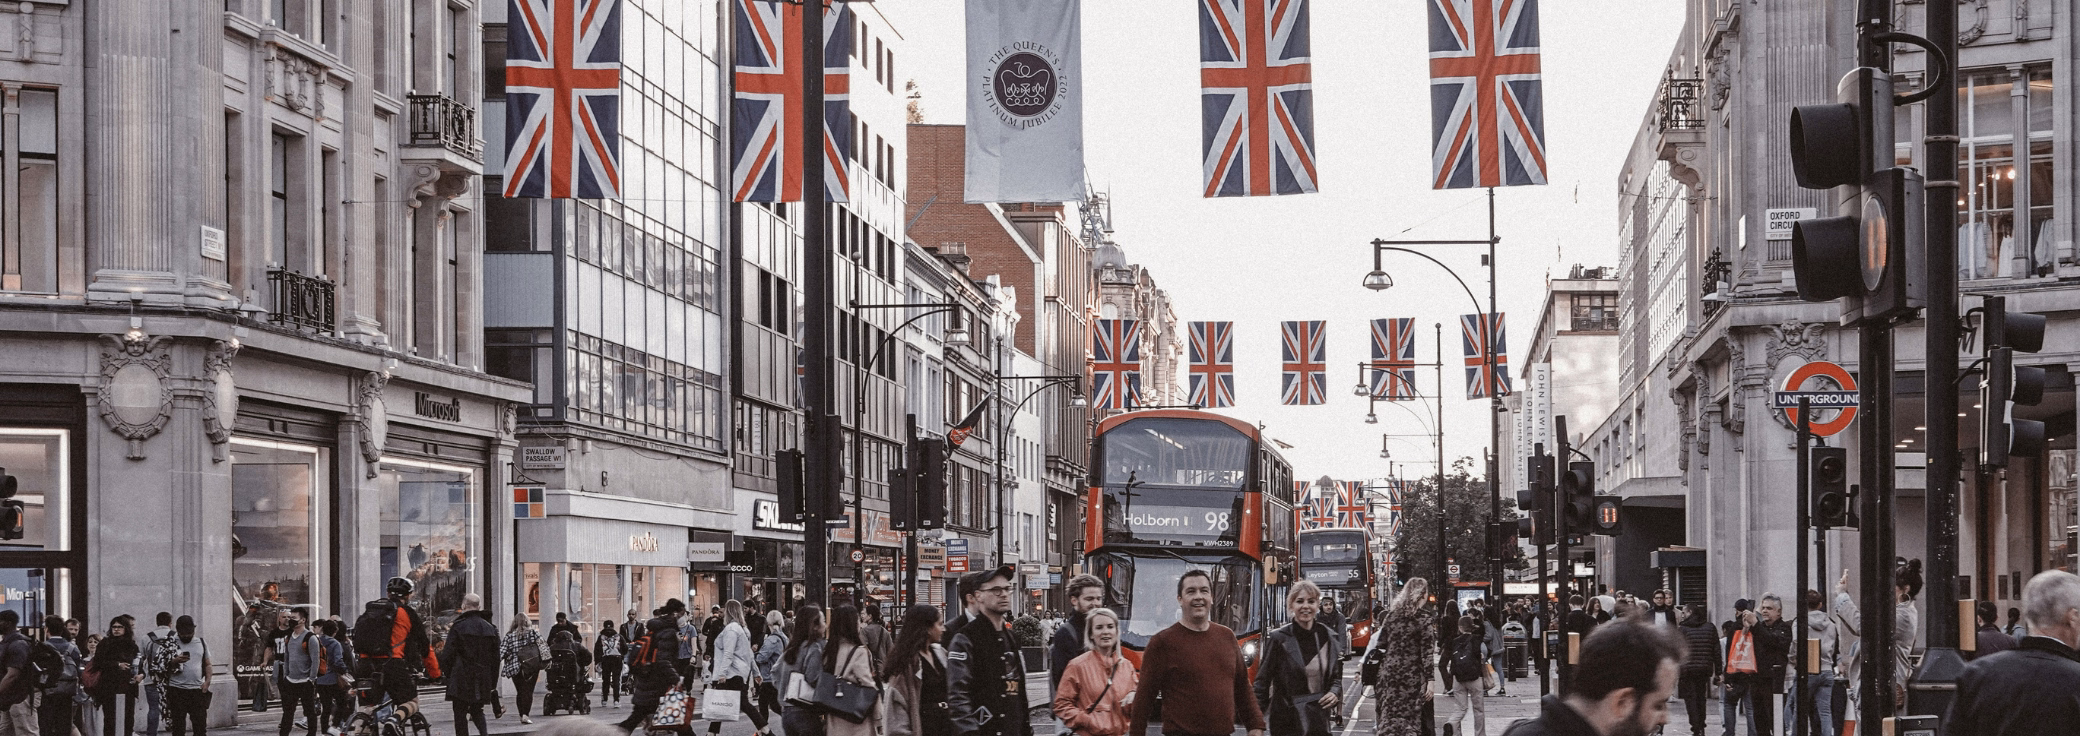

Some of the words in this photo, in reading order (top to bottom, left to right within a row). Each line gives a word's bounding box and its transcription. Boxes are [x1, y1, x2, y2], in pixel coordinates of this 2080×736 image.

[989, 46, 1010, 65] THE
[1013, 41, 1059, 65] QUEEN'S
[983, 76, 1017, 126] PLATINUM
[1022, 102, 1062, 130] JUBILEE
[1058, 75, 1067, 99] 2022
[1770, 211, 1800, 220] OXFORD
[1770, 221, 1792, 229] CIRCU
[1537, 369, 1545, 398] JOHN
[415, 391, 461, 422] Microsoft
[1779, 395, 1860, 404] UNRGROUN
[1538, 403, 1546, 437] LEWIS
[1122, 512, 1180, 527] Holborn
[1204, 511, 1230, 531] 98
[1348, 570, 1359, 579] 55
